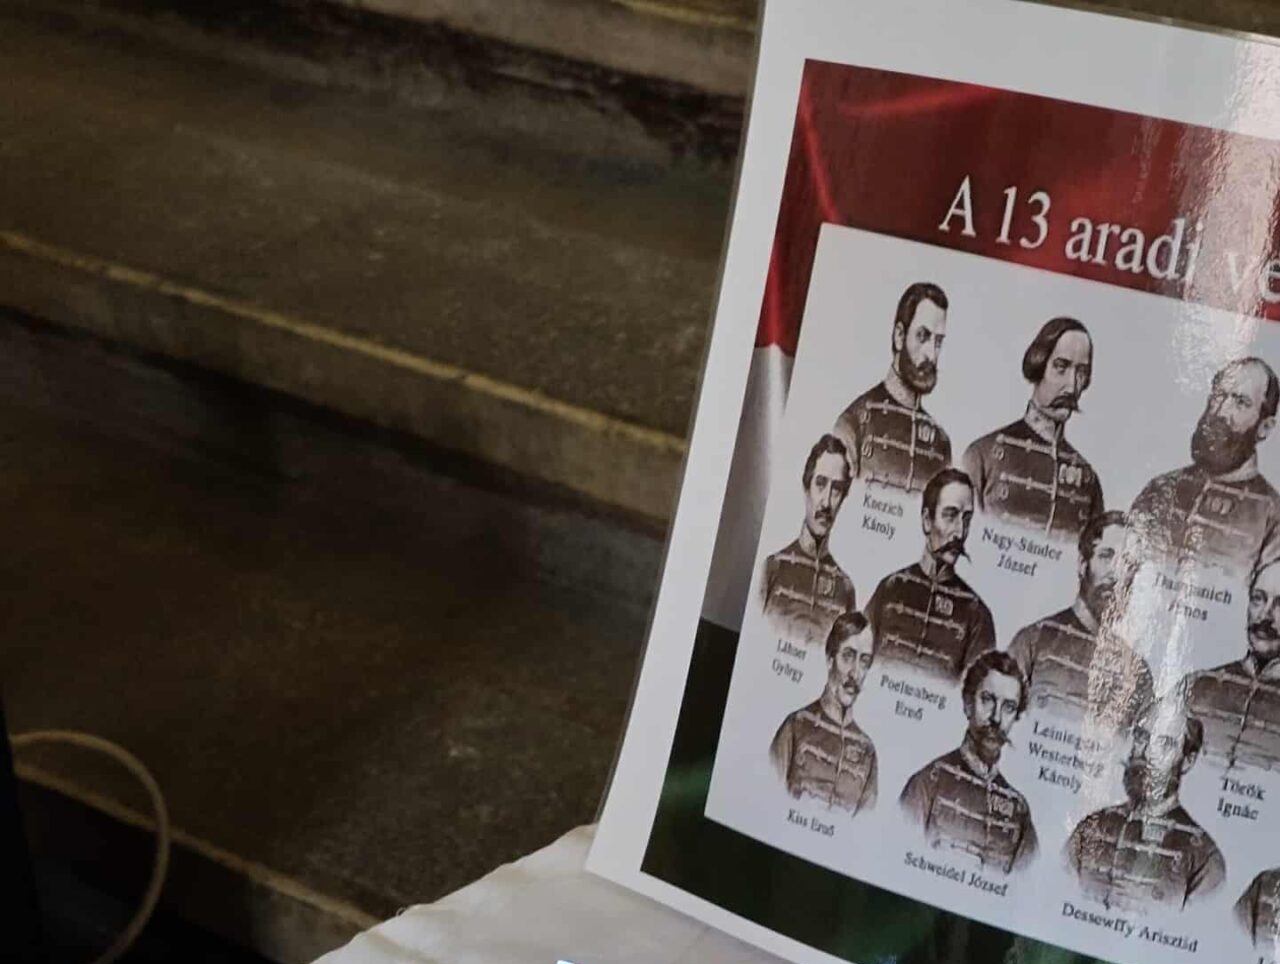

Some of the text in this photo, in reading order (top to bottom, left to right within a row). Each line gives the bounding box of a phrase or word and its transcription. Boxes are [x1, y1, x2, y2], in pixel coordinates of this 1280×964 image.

[938, 174, 977, 238] A
[995, 186, 1051, 250] 13
[1064, 216, 1203, 284] aradi
[861, 515, 897, 541] Károly
[982, 526, 1064, 563] Nagy-Sándor
[997, 554, 1039, 578] József
[1038, 764, 1082, 794] Károly
[1217, 797, 1260, 820] Ignác
[967, 873, 1009, 898] József
[1138, 926, 1199, 953] Arisztid
